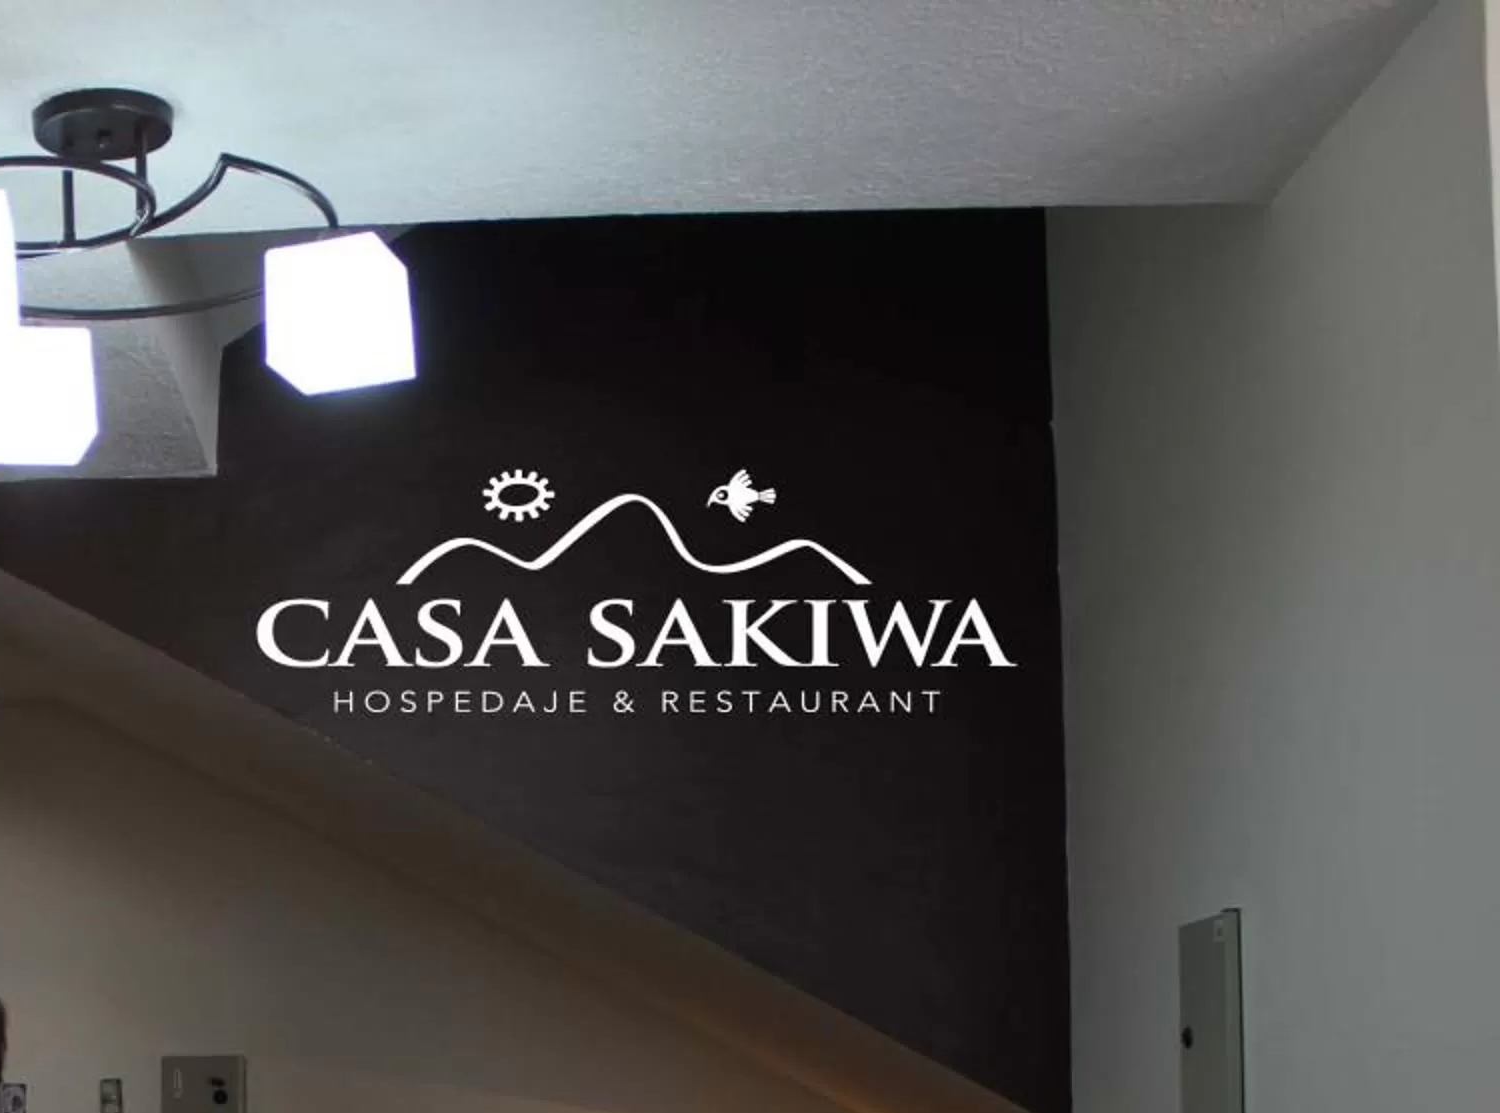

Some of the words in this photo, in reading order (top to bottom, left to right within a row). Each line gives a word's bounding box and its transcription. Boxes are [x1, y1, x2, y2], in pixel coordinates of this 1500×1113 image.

[255, 597, 551, 669] CASA
[587, 597, 1018, 669] SAKIWA
[333, 690, 588, 713] HOSPEDAJE
[613, 690, 635, 713] &
[661, 690, 942, 713] RESTAURANT
